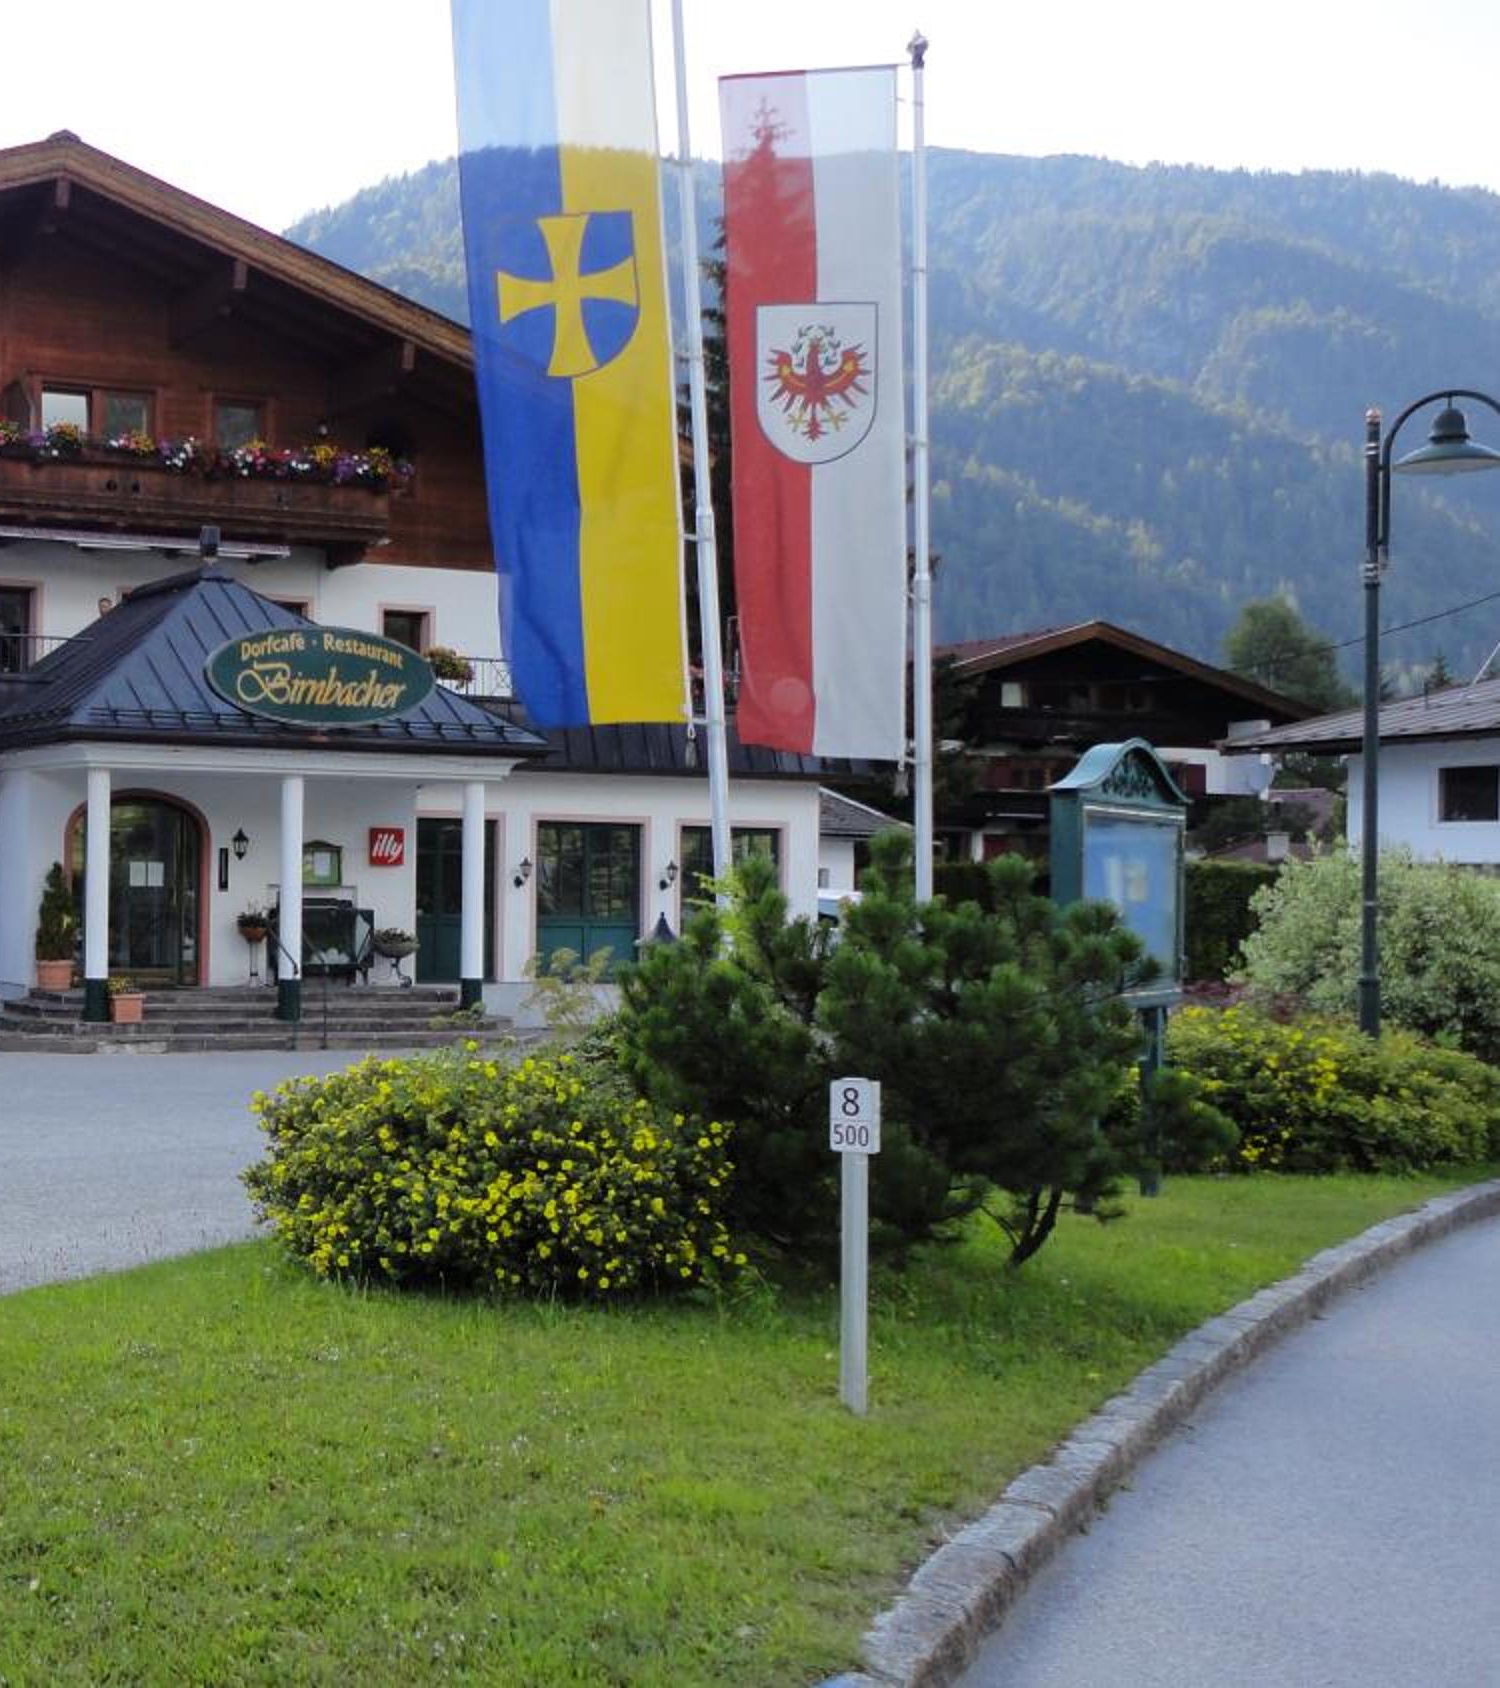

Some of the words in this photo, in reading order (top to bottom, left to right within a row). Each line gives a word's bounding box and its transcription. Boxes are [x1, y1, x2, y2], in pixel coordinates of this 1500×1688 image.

[322, 632, 404, 669] Restaurant
[237, 661, 406, 707] Birnbacher
[372, 833, 403, 862] illy
[842, 1087, 859, 1116] 8
[834, 1124, 868, 1146] 500
